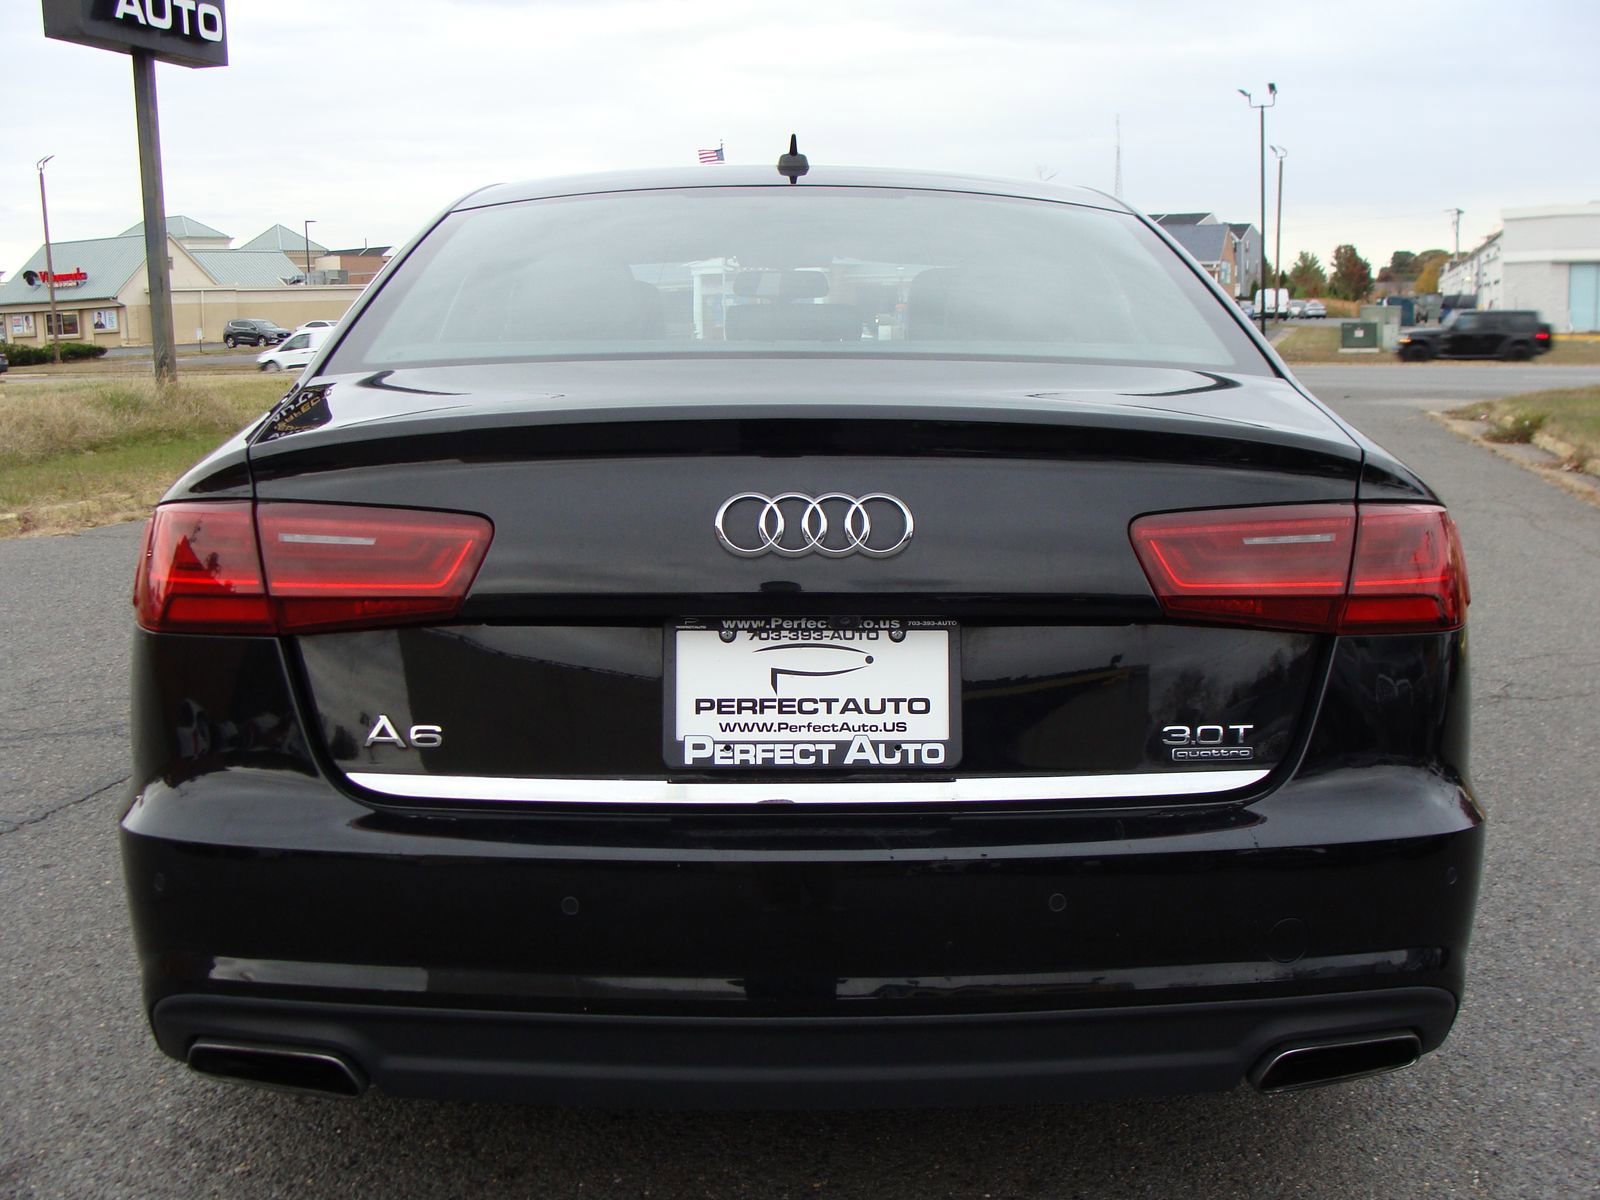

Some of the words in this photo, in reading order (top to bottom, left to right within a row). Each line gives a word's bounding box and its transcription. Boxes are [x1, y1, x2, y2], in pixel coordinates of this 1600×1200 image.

[115, 0, 223, 42] AUTO
[721, 617, 900, 629] www.Perfeco.us
[747, 630, 880, 641] 703-393-AUTO
[695, 697, 931, 715] PERFECTAUTO
[363, 714, 443, 749] A6
[718, 722, 908, 733] WWW.PerfectAuto.US
[683, 735, 836, 765] PERFECT
[843, 735, 946, 765] AUTO
[1176, 749, 1250, 759] quattro
